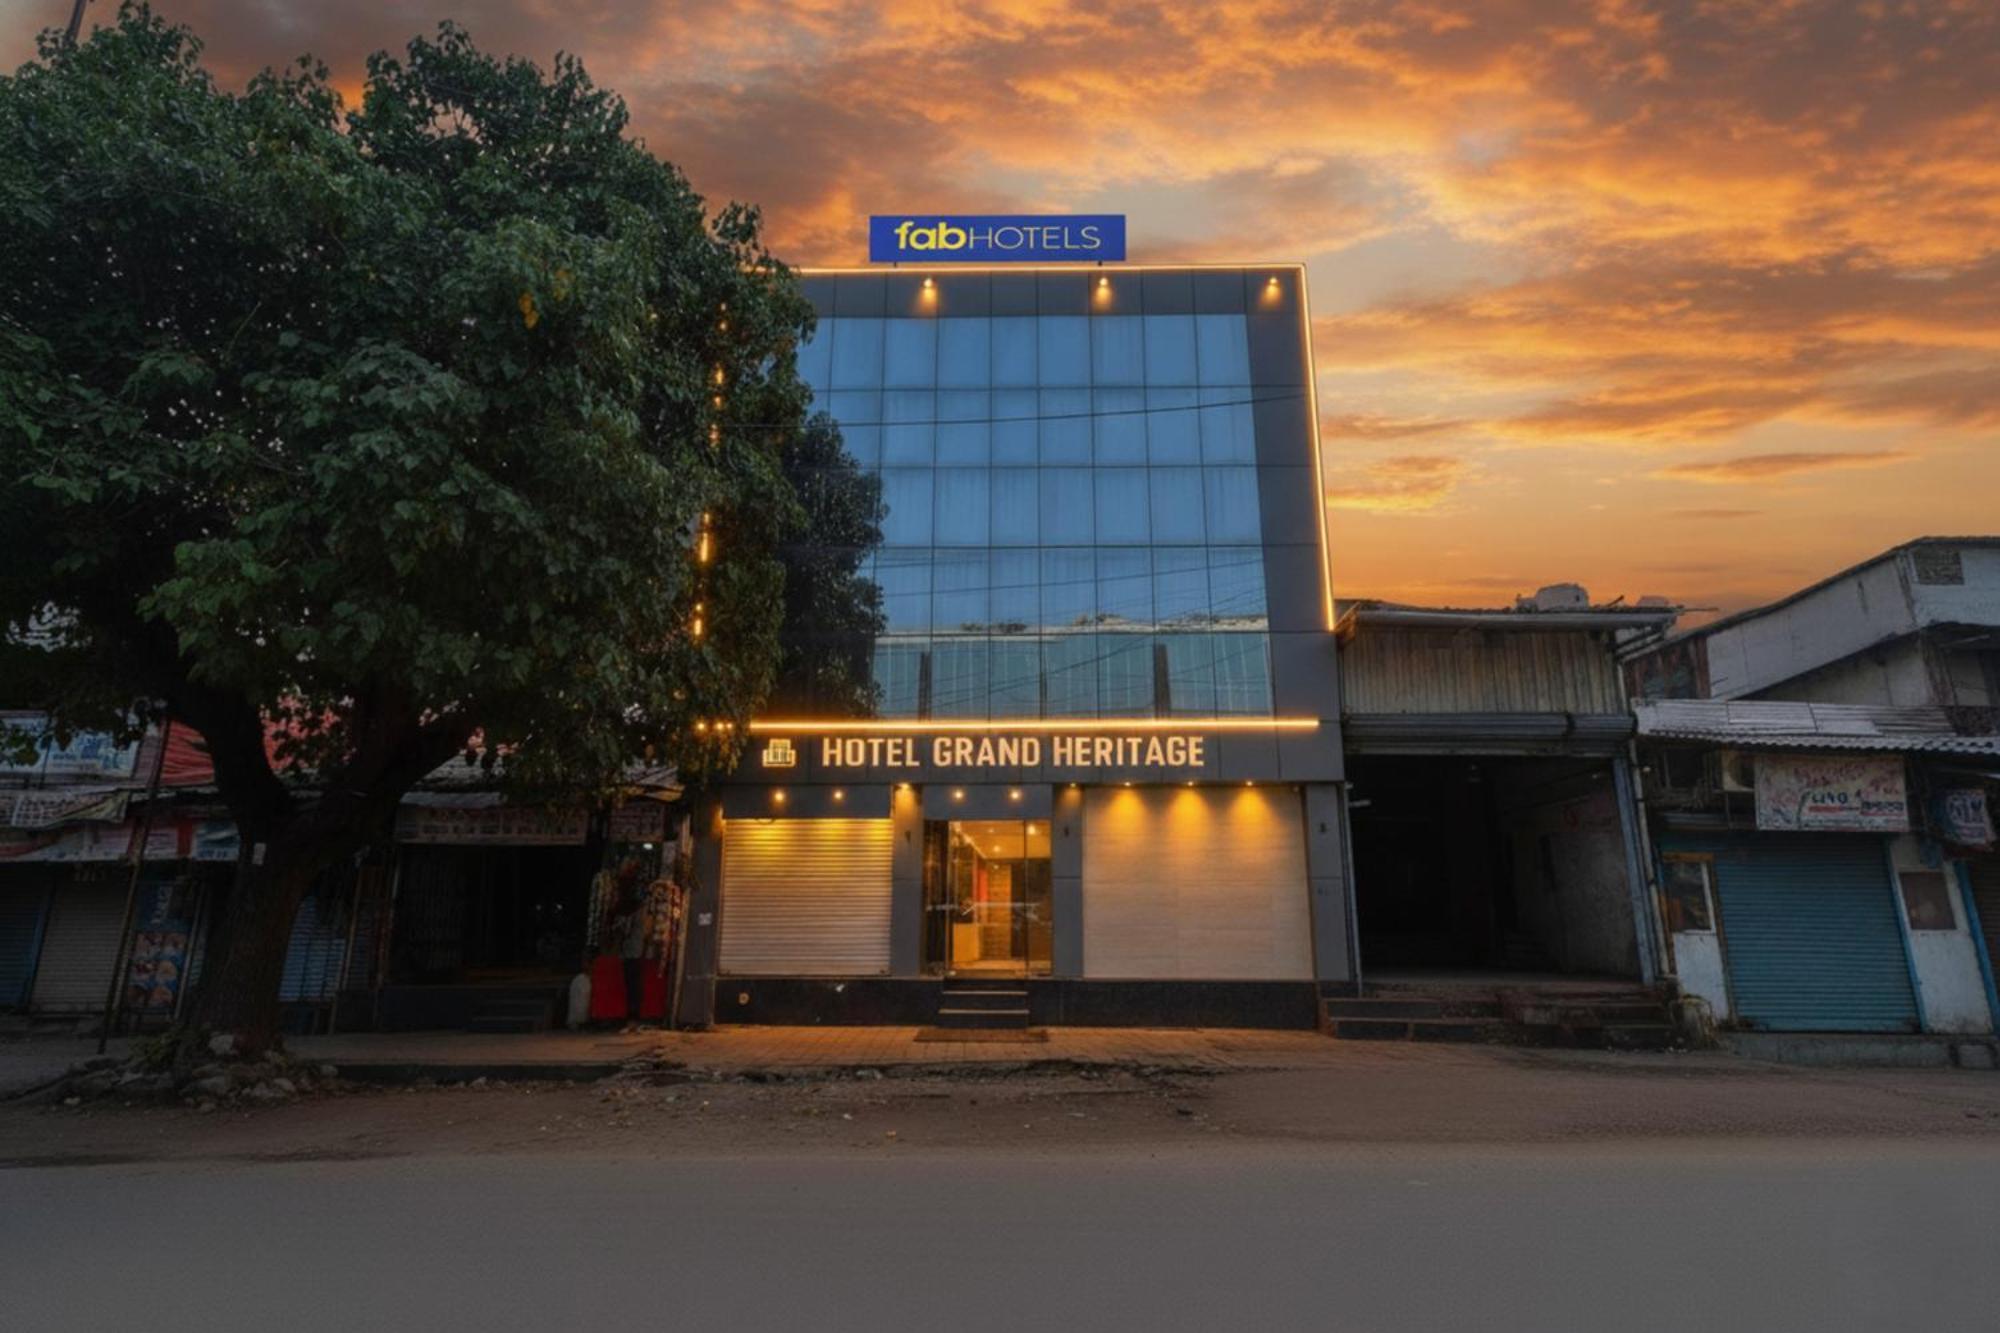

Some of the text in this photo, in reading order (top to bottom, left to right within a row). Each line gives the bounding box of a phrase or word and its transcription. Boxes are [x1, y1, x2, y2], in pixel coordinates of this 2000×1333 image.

[894, 220, 1102, 251] fabHOTELS
[822, 736, 1205, 768] HOTEL GRAND HERITAGE
